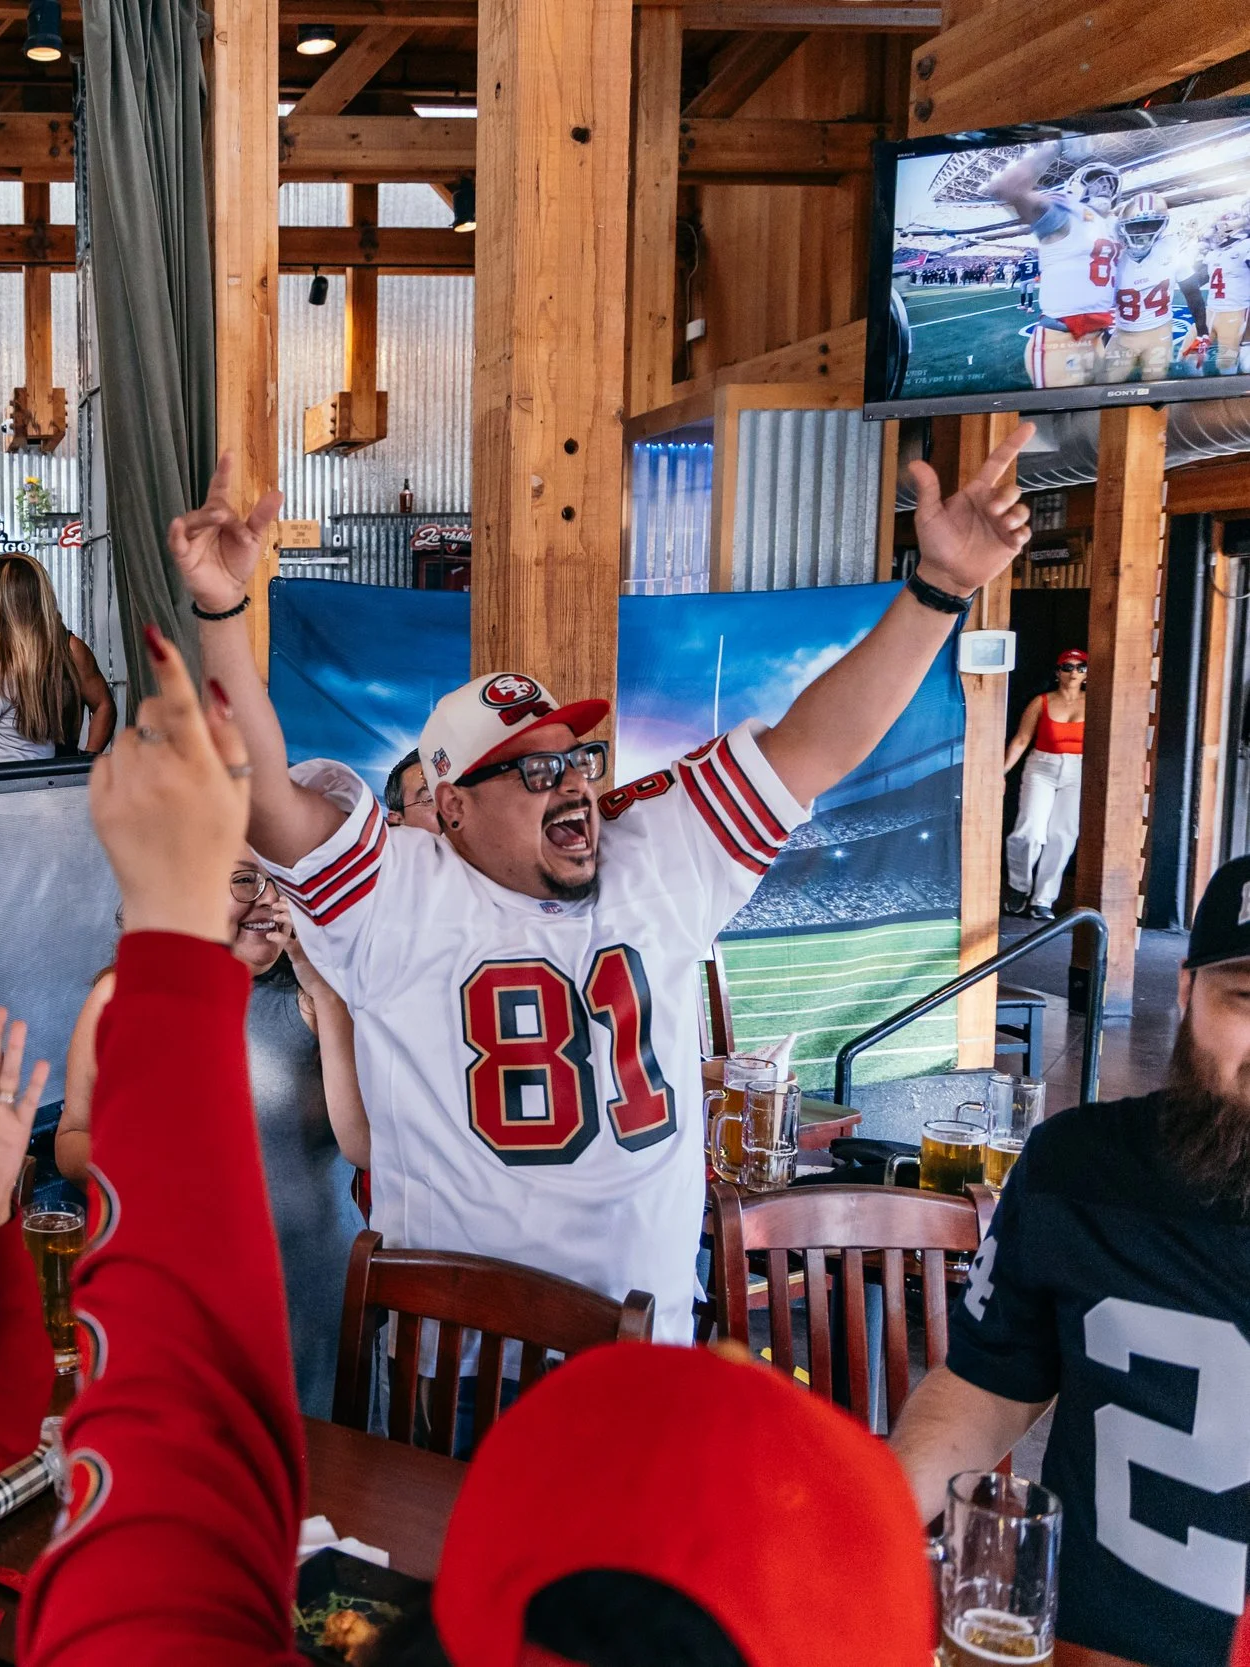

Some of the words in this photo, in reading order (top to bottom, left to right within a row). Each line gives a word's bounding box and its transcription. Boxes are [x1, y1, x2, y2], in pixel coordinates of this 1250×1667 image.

[1115, 278, 1171, 322] 84
[1107, 390, 1136, 398] SONY
[460, 943, 678, 1167] 81
[1083, 1296, 1250, 1617] 2
